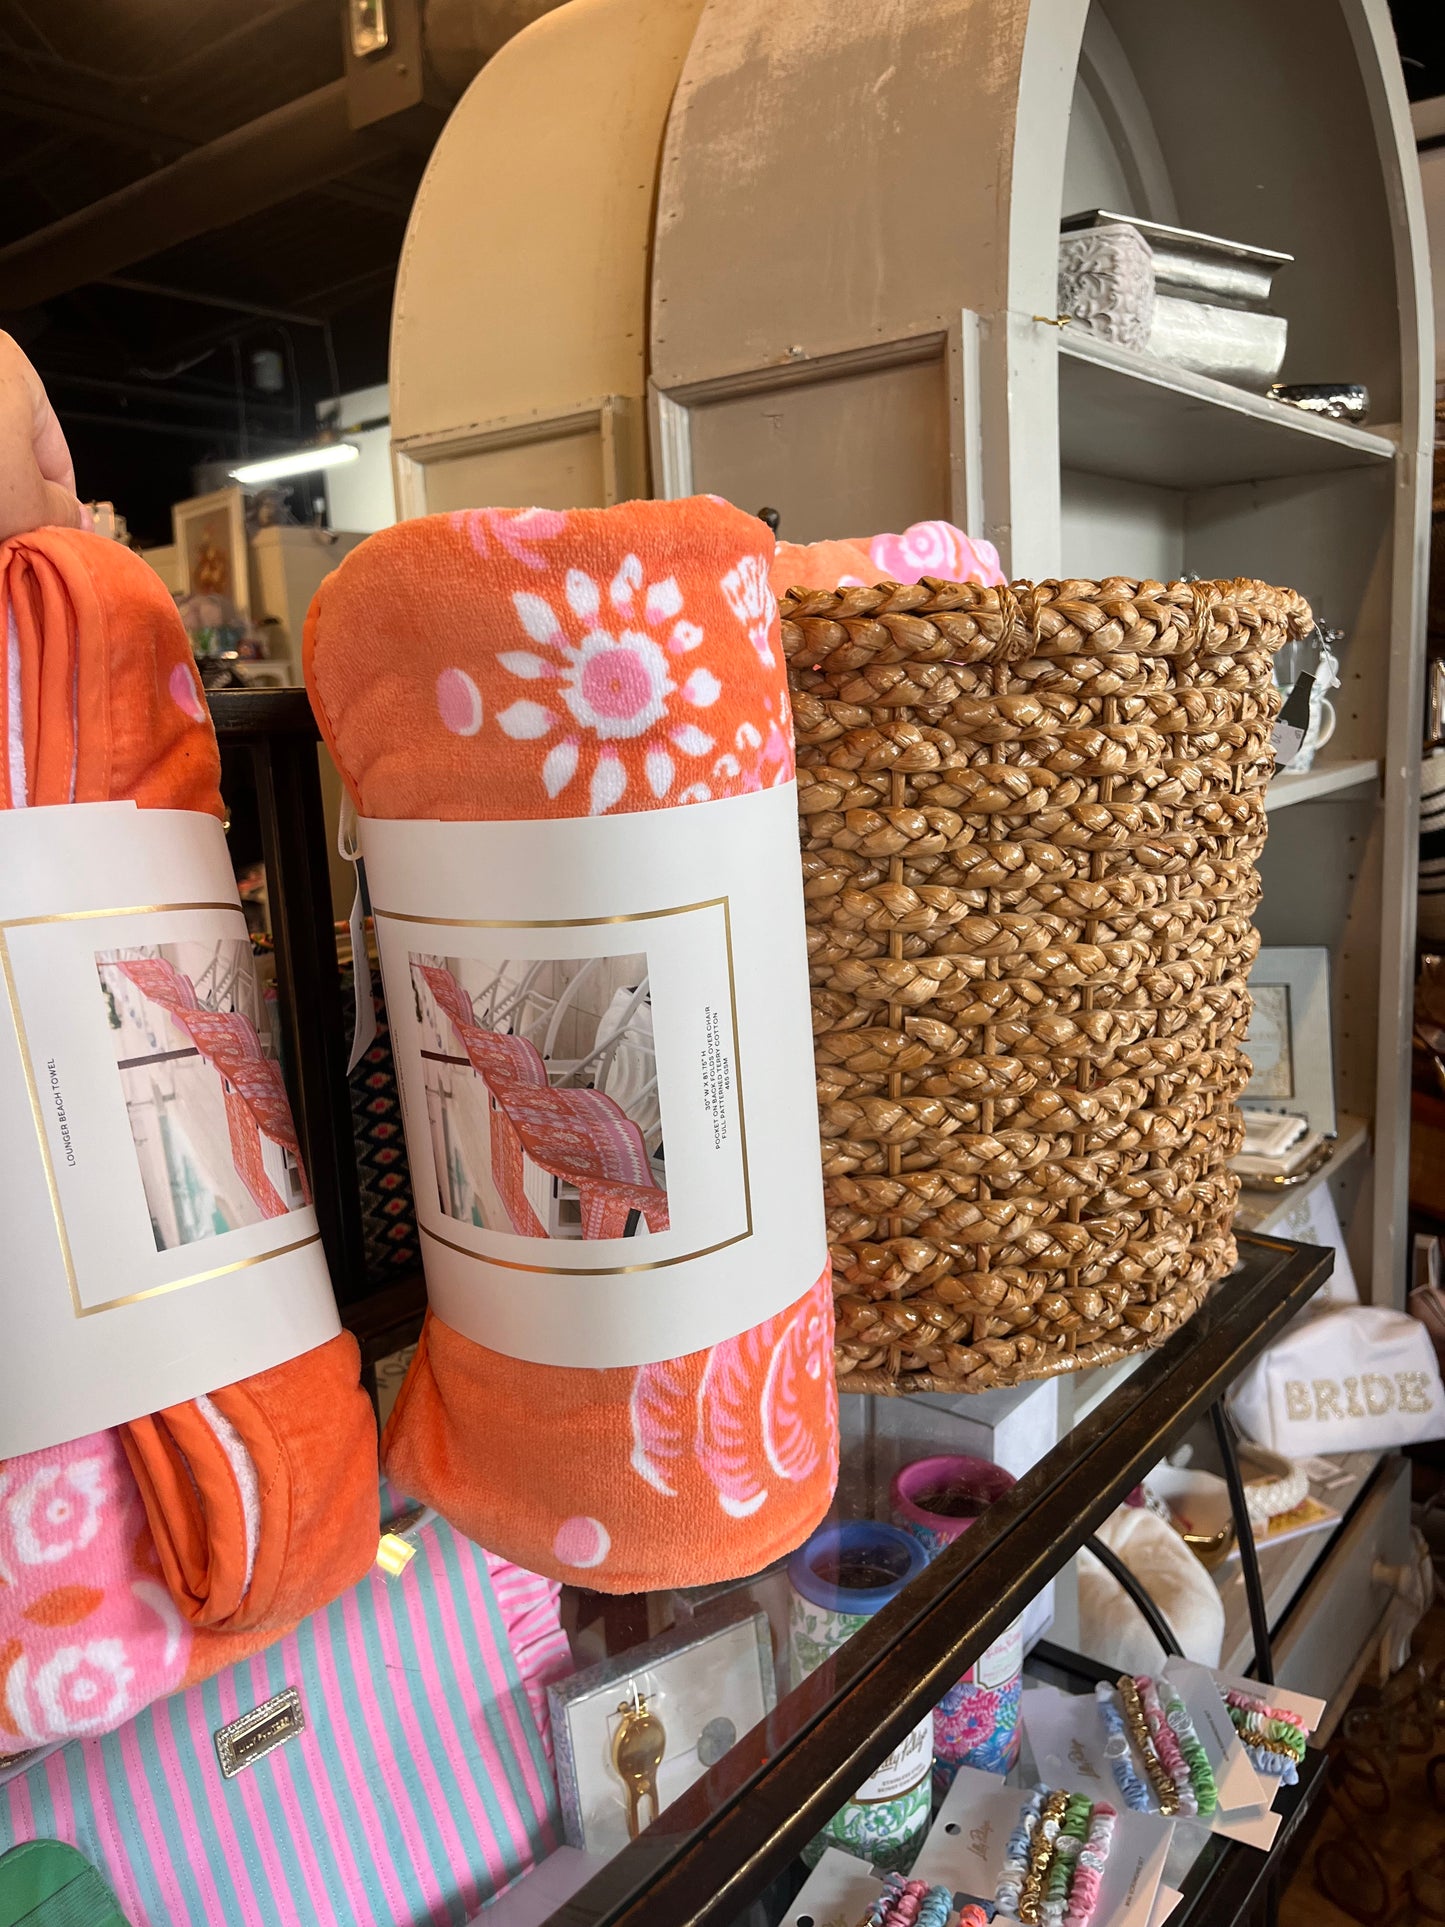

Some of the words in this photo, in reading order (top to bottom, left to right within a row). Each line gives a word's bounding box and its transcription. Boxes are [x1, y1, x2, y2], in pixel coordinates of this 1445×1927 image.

[704, 1006, 712, 1032] CHAIR
[712, 1012, 720, 1047] COTTON
[48, 1058, 59, 1090] TOWEL
[708, 1056, 716, 1082] FOLDS
[54, 1092, 66, 1122] BEACH
[704, 1089, 710, 1097] W
[710, 1083, 718, 1104] BACK
[718, 1074, 726, 1119] PATTERNED
[712, 1105, 719, 1117] ON
[61, 1123, 76, 1167] LOUNGER
[713, 1119, 721, 1150] POCKET
[1284, 1371, 1433, 1422] BRIDE
